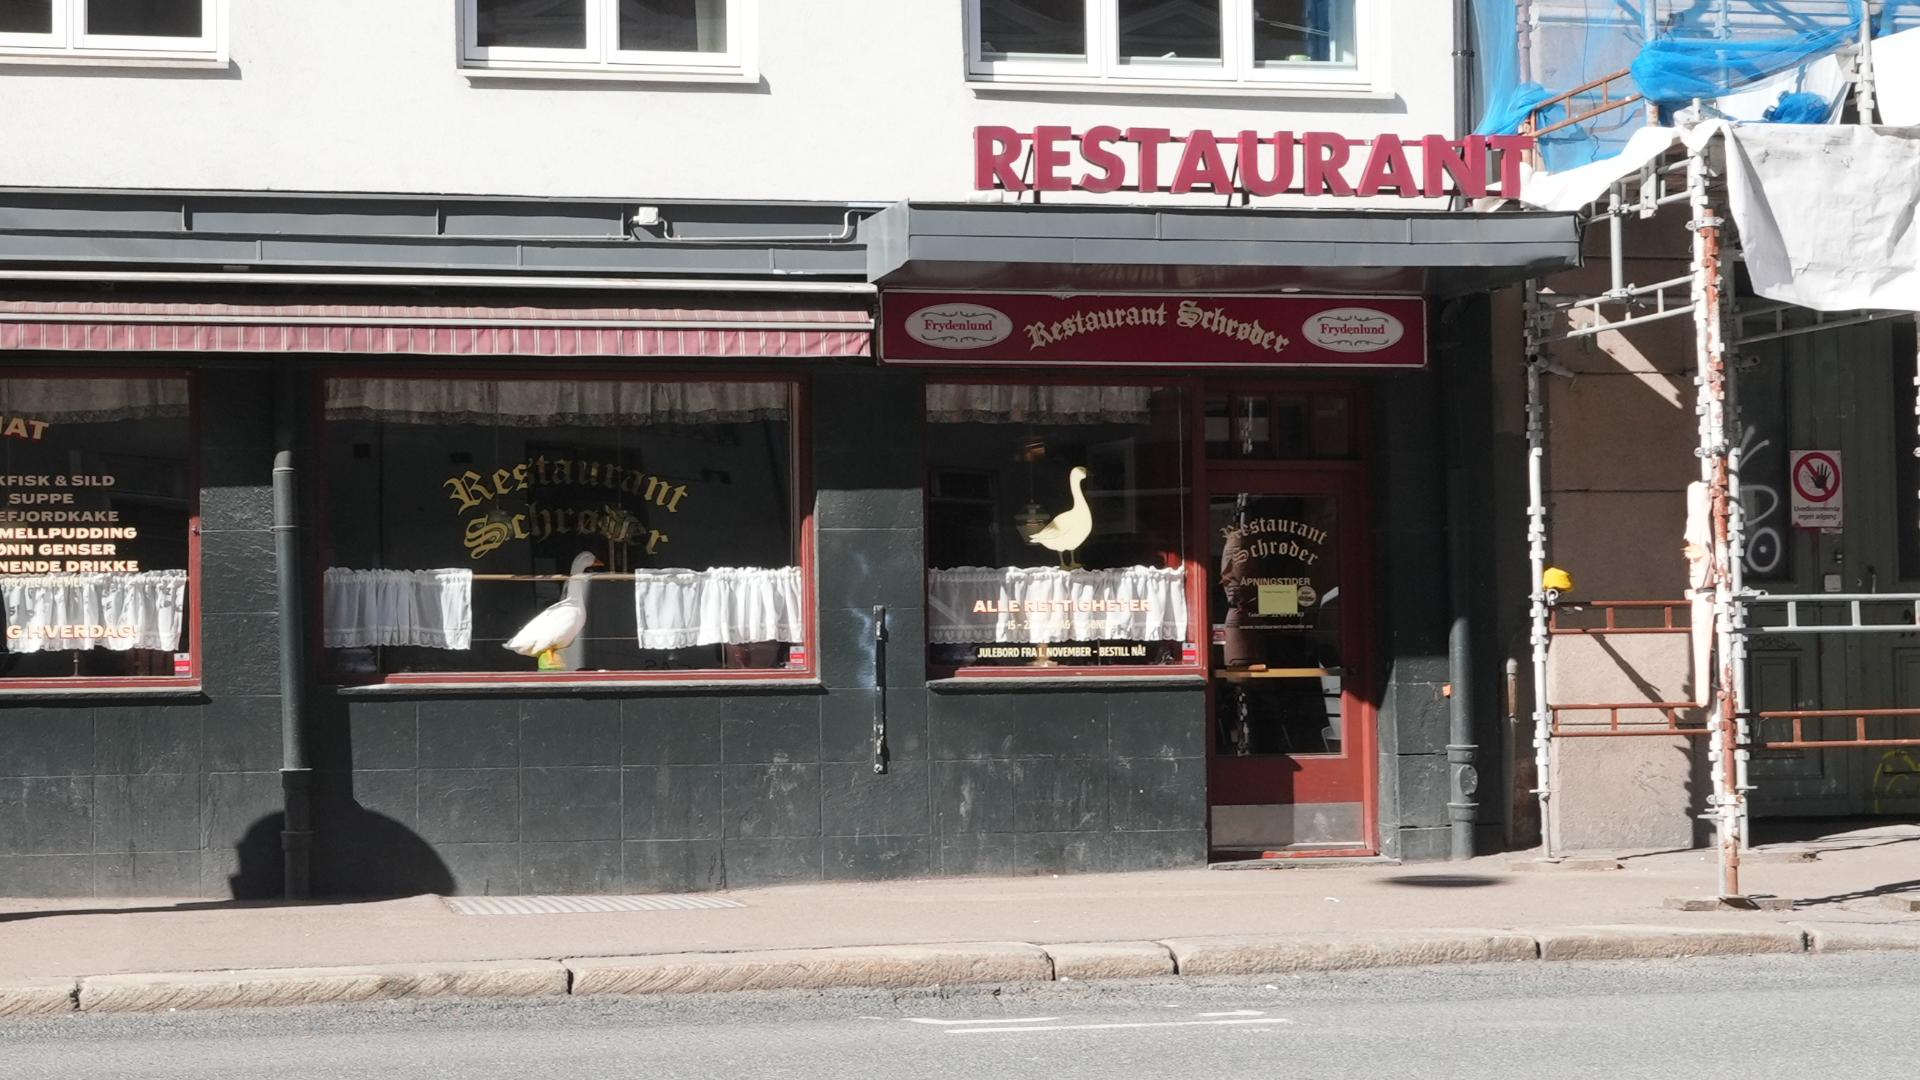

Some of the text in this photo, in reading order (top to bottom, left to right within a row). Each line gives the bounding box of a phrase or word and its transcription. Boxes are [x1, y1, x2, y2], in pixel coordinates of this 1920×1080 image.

[974, 126, 1534, 199] RESTAURANT
[923, 319, 993, 333] Frydenlund
[1023, 300, 1290, 352] Restaurant Schrøder
[1319, 322, 1386, 337] Frydenlund
[0, 416, 49, 440] AT
[55, 475, 68, 487] &
[71, 475, 116, 487] SILD
[442, 455, 689, 516] Restaurant
[8, 493, 75, 505] SUPPE
[0, 511, 120, 523] EFJORDKAKE
[0, 527, 138, 540] MELLPUDDING
[38, 544, 117, 556] GENSER
[1232, 538, 1319, 566] Schrøder
[0, 561, 140, 573] NENDE DRIKKE
[973, 599, 1152, 613] ALLE RETTIGHETER
[977, 647, 1020, 658] JULEBORD
[1021, 647, 1037, 657] FRA
[1045, 647, 1091, 657] NOVEMBER
[1099, 647, 1130, 656] BESTILL
[1131, 645, 1146, 656] NÅ!
